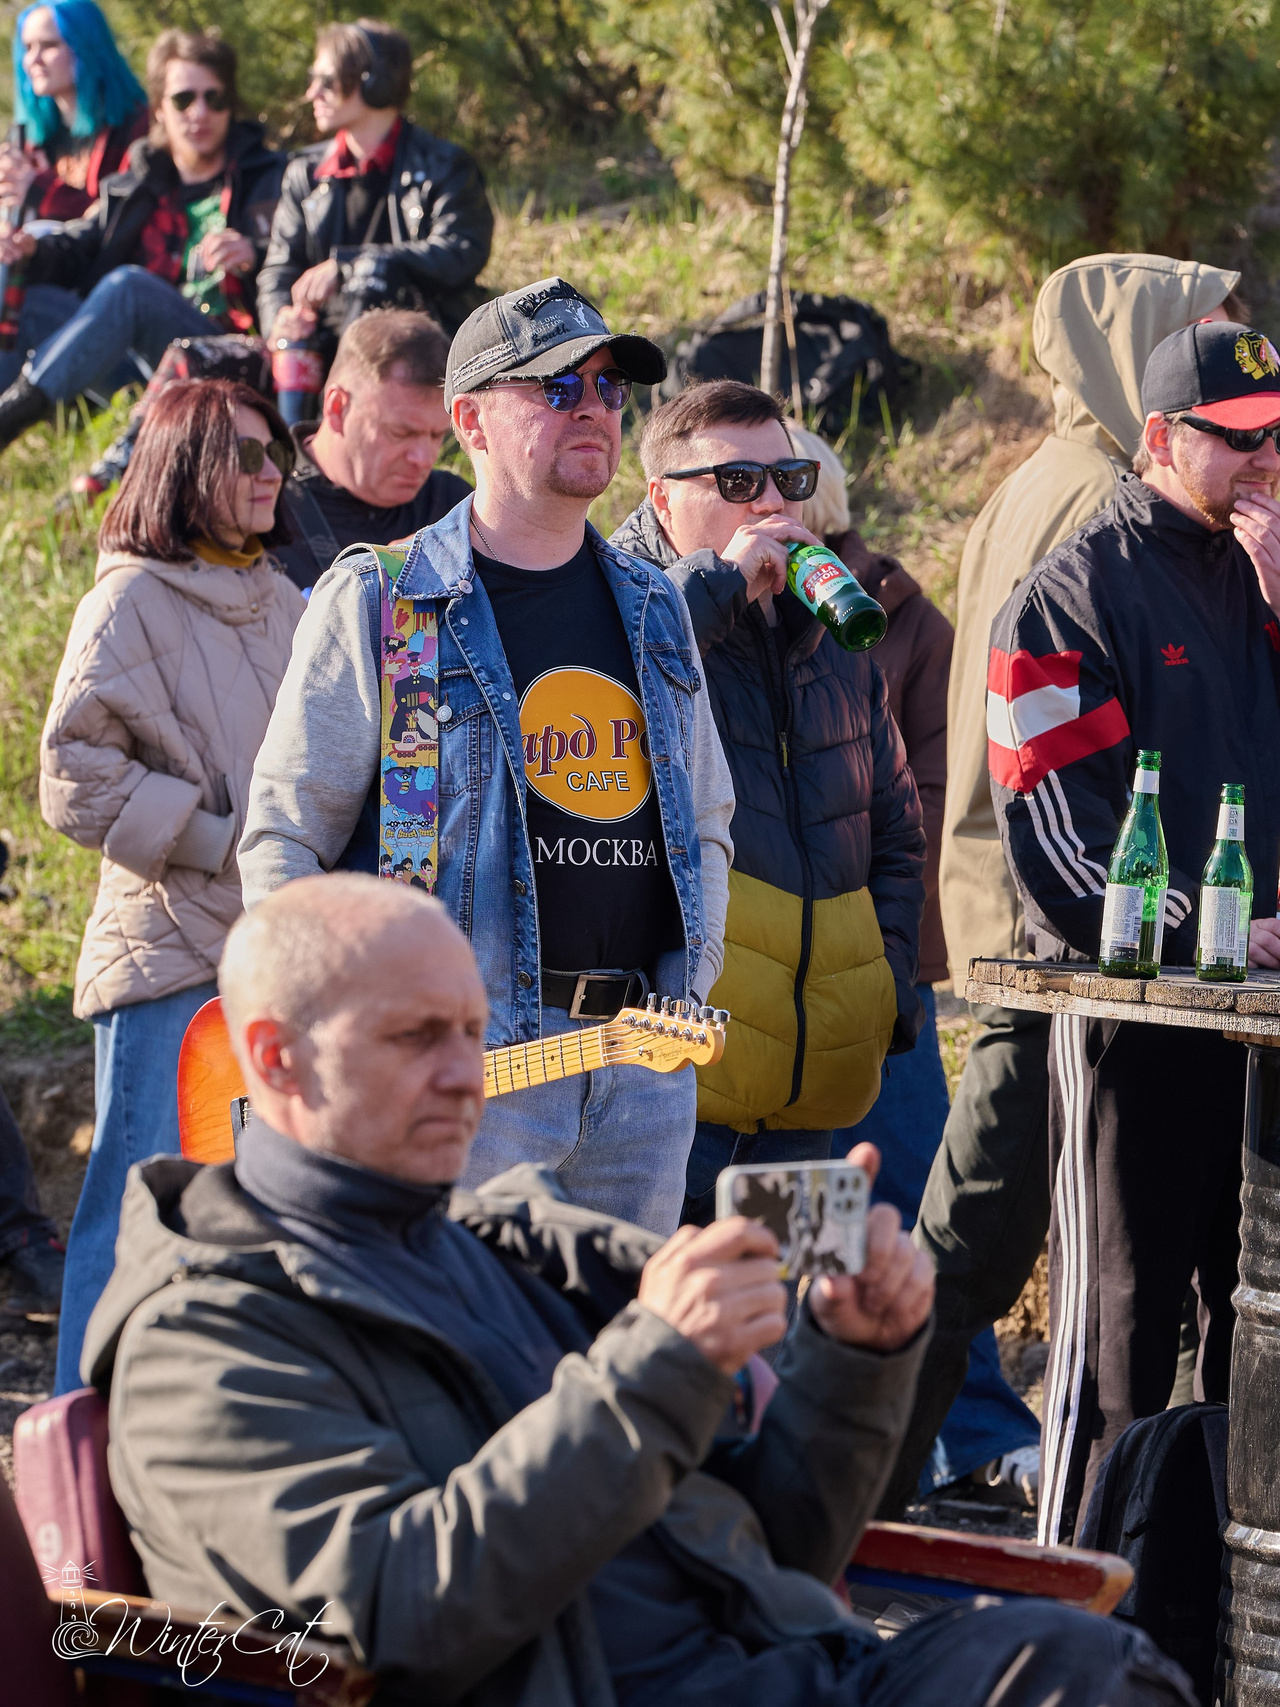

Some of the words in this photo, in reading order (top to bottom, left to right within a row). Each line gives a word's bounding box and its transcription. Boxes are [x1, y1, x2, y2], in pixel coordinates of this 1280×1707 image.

[531, 323, 570, 347] South
[806, 565, 836, 590] STELLA
[522, 713, 598, 778] ард
[566, 770, 631, 793] CAFE
[534, 836, 659, 867] МОСКВА
